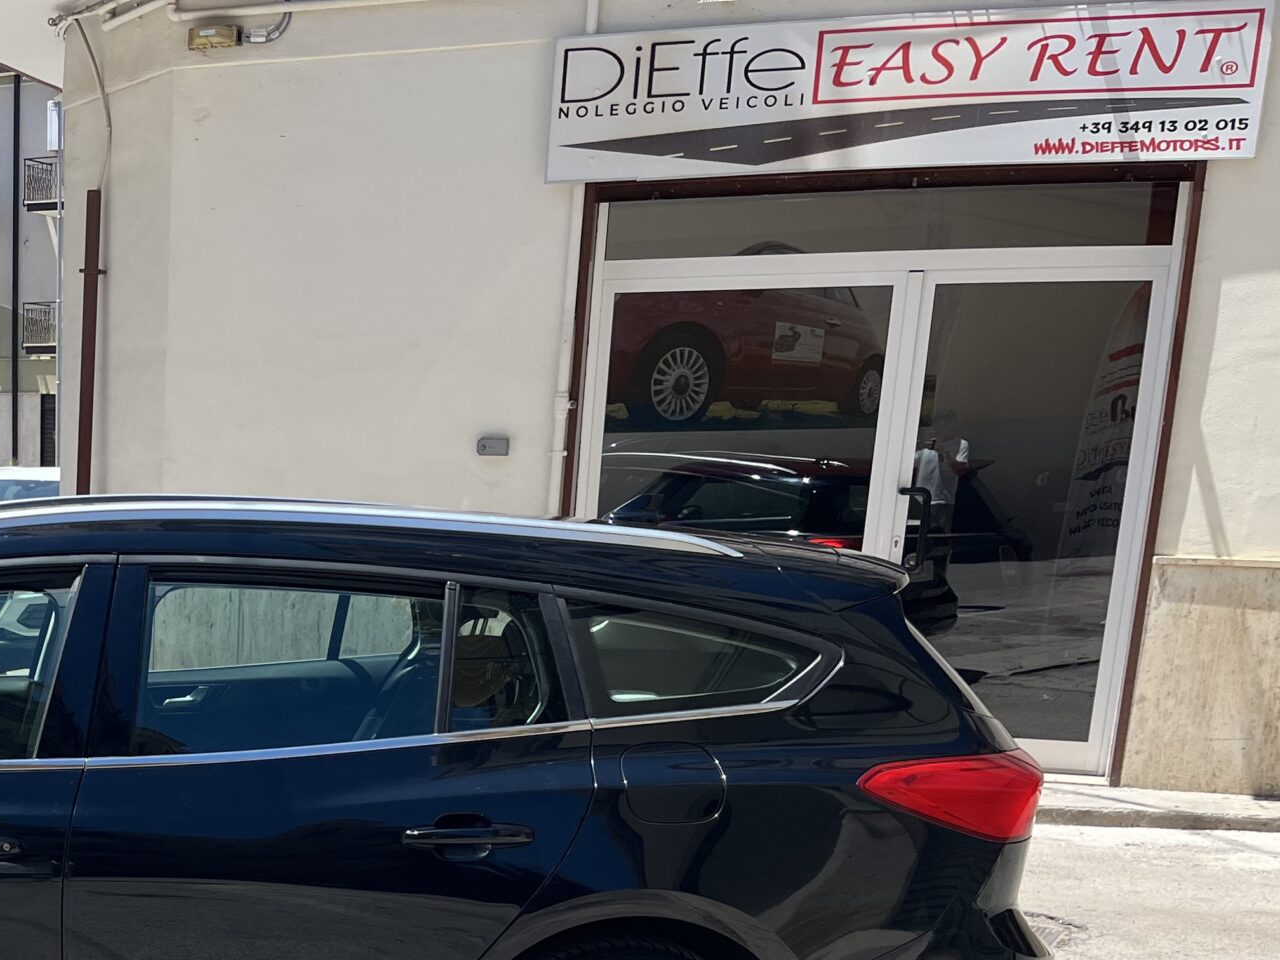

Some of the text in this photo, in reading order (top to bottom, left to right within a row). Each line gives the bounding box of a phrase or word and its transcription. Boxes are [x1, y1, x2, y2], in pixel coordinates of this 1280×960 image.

[560, 36, 806, 104] DiEffe
[830, 36, 1008, 88] EASY
[1026, 22, 1249, 82] RENT
[558, 93, 806, 119] NOLEGGIO VEICOLI
[1079, 117, 1250, 134] +39 349 13 02 015
